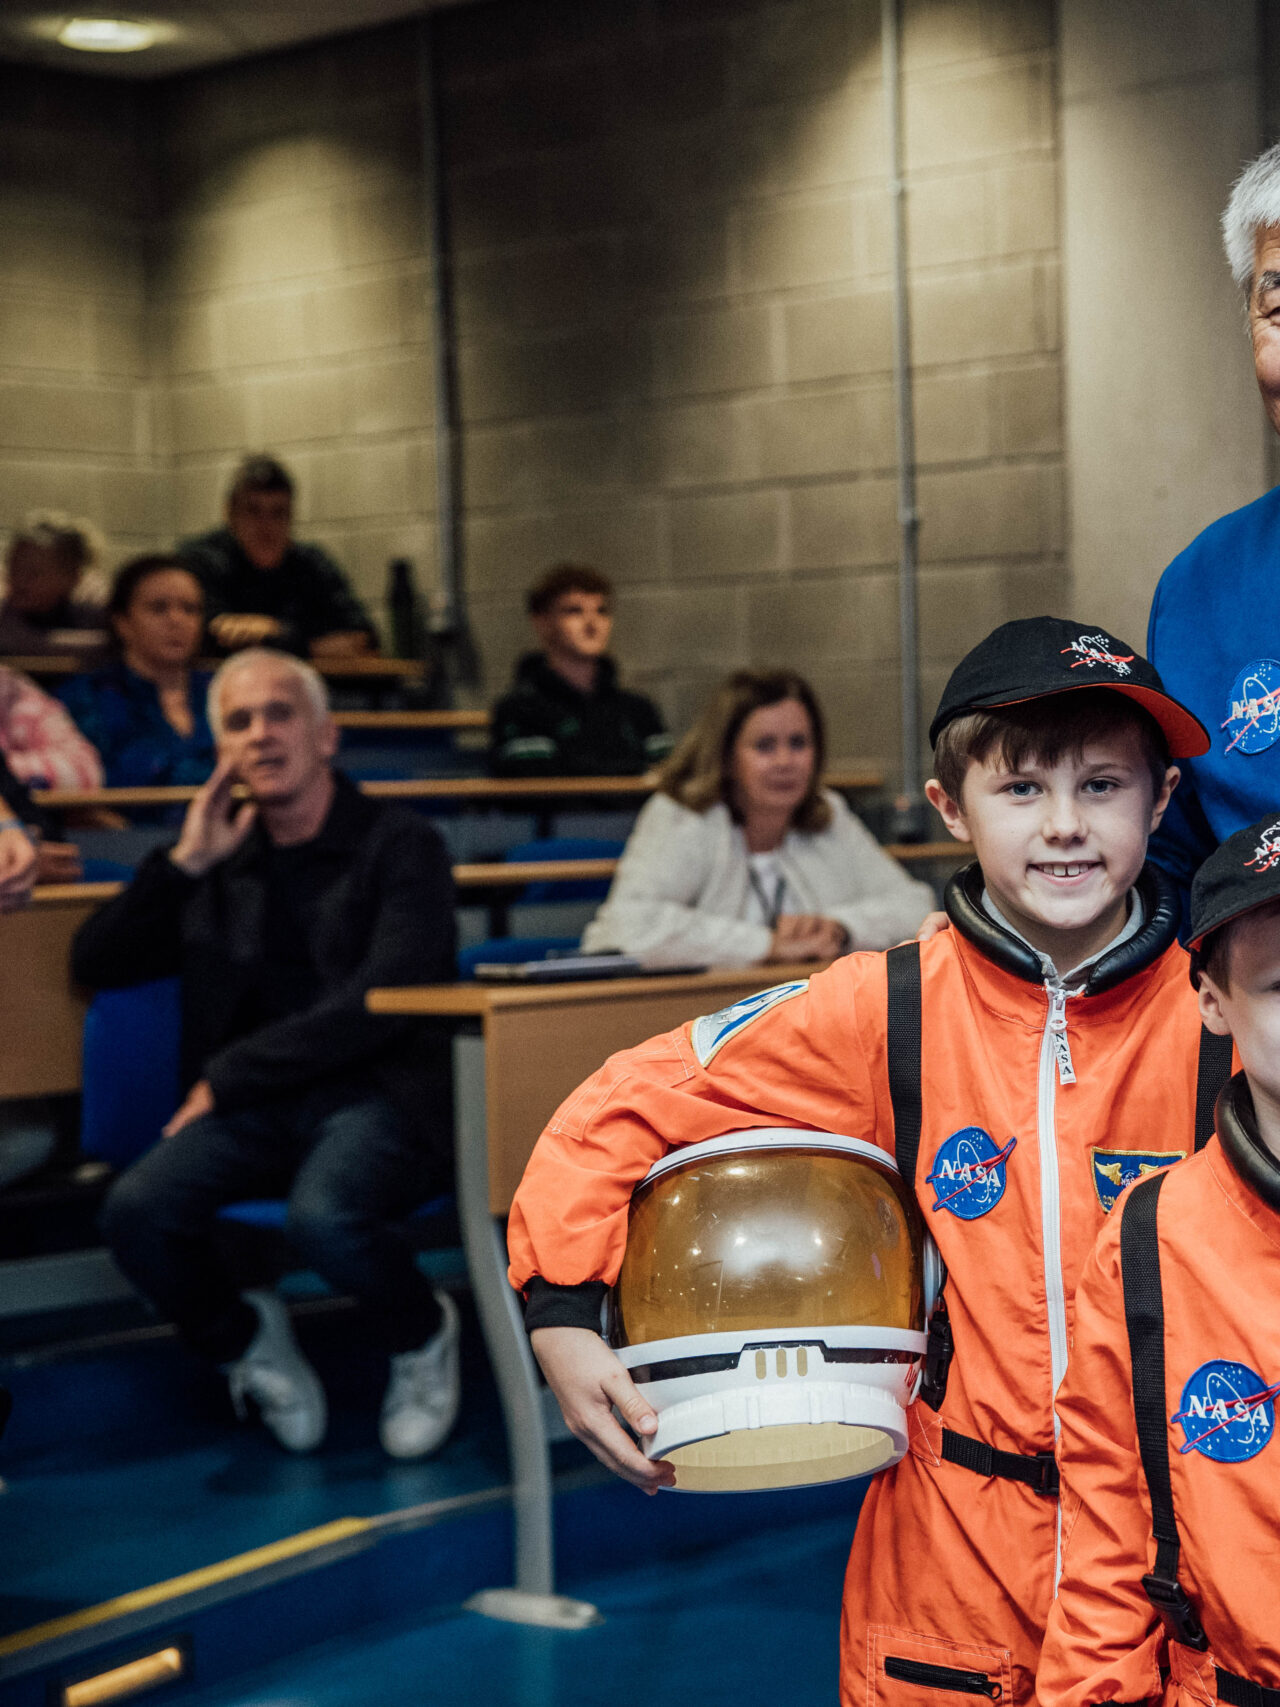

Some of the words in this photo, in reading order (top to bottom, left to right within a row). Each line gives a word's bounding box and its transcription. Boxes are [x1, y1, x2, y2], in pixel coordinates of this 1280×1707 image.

[1055, 1032, 1072, 1075] NASA
[939, 1158, 1001, 1189] NASA
[1188, 1395, 1270, 1427] NASA
